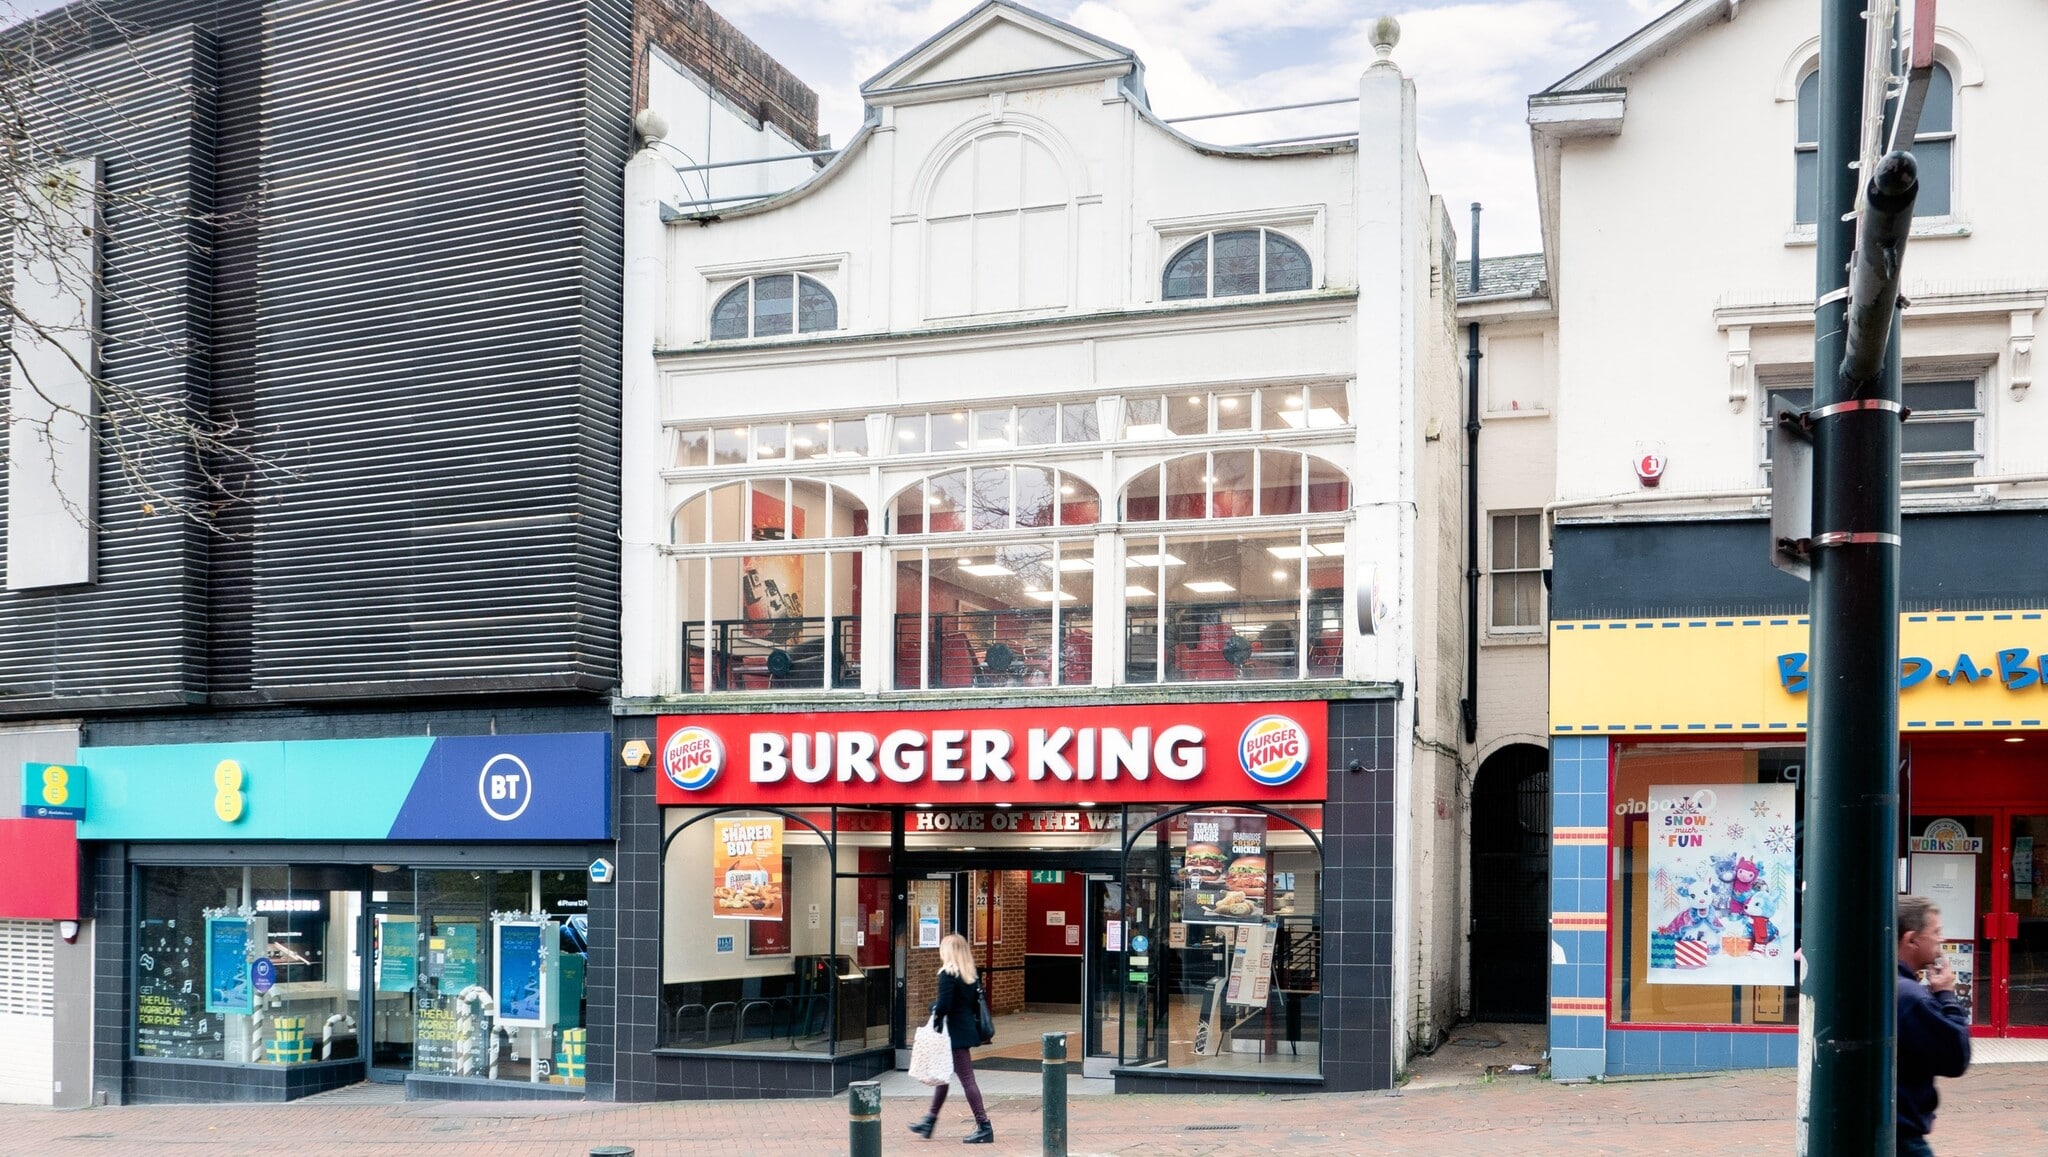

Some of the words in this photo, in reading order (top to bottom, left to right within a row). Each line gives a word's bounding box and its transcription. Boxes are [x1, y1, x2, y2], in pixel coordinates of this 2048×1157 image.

[1247, 728, 1297, 753] BURGER
[669, 738, 711, 761] BURGER
[749, 729, 1014, 784] BURGER
[1028, 725, 1206, 782] KING
[1249, 739, 1299, 770] KING
[671, 748, 712, 776] KING
[491, 774, 520, 800] BT
[916, 812, 984, 830] HOME
[991, 812, 1024, 831] OF
[1029, 811, 1080, 831] THE
[1665, 815, 1707, 826] SNOW
[722, 825, 773, 843] SHARER
[1674, 826, 1698, 834] much
[1193, 833, 1219, 842] ANGUS
[1668, 834, 1703, 848] FUN
[727, 840, 754, 857] BOX
[1232, 846, 1261, 854] CHICKEN
[1911, 838, 1980, 852] WORKSHOP
[256, 899, 320, 911] SAMSUNG
[140, 985, 154, 994] GET
[140, 995, 154, 1004] THE
[154, 996, 171, 1006] FULL
[418, 998, 435, 1008] GET
[140, 1015, 153, 1024] FOR
[418, 1008, 435, 1018] THE
[436, 1010, 456, 1020] FULL
[418, 1020, 448, 1030] WORKS
[418, 1030, 435, 1040] FOR
